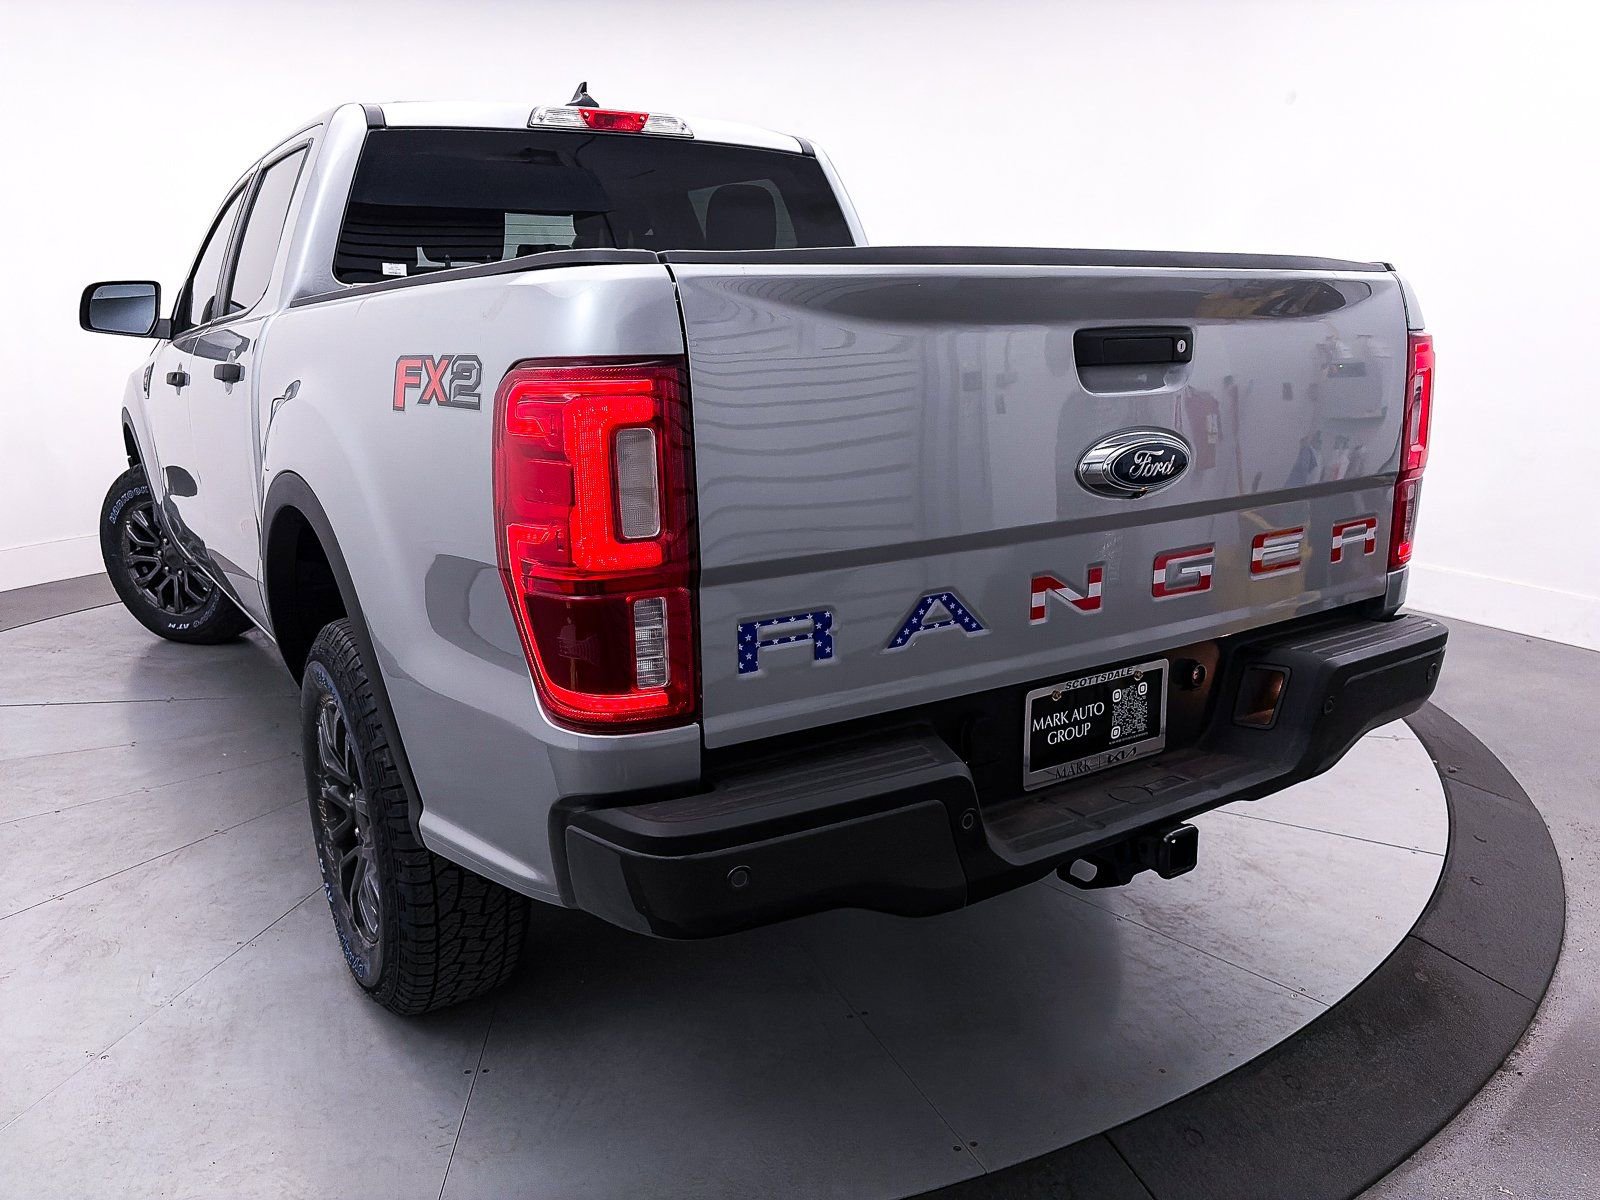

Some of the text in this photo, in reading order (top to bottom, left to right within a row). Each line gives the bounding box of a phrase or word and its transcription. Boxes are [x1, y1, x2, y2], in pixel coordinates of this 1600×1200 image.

[393, 354, 482, 411] FX2
[1129, 449, 1176, 479] Ford
[737, 516, 1376, 675] RANGER
[1064, 667, 1133, 690] SCOTTSDALE
[1032, 702, 1105, 732] MARK AUTO
[1047, 722, 1091, 745] GROUP
[1055, 747, 1137, 779] MARK KIA
